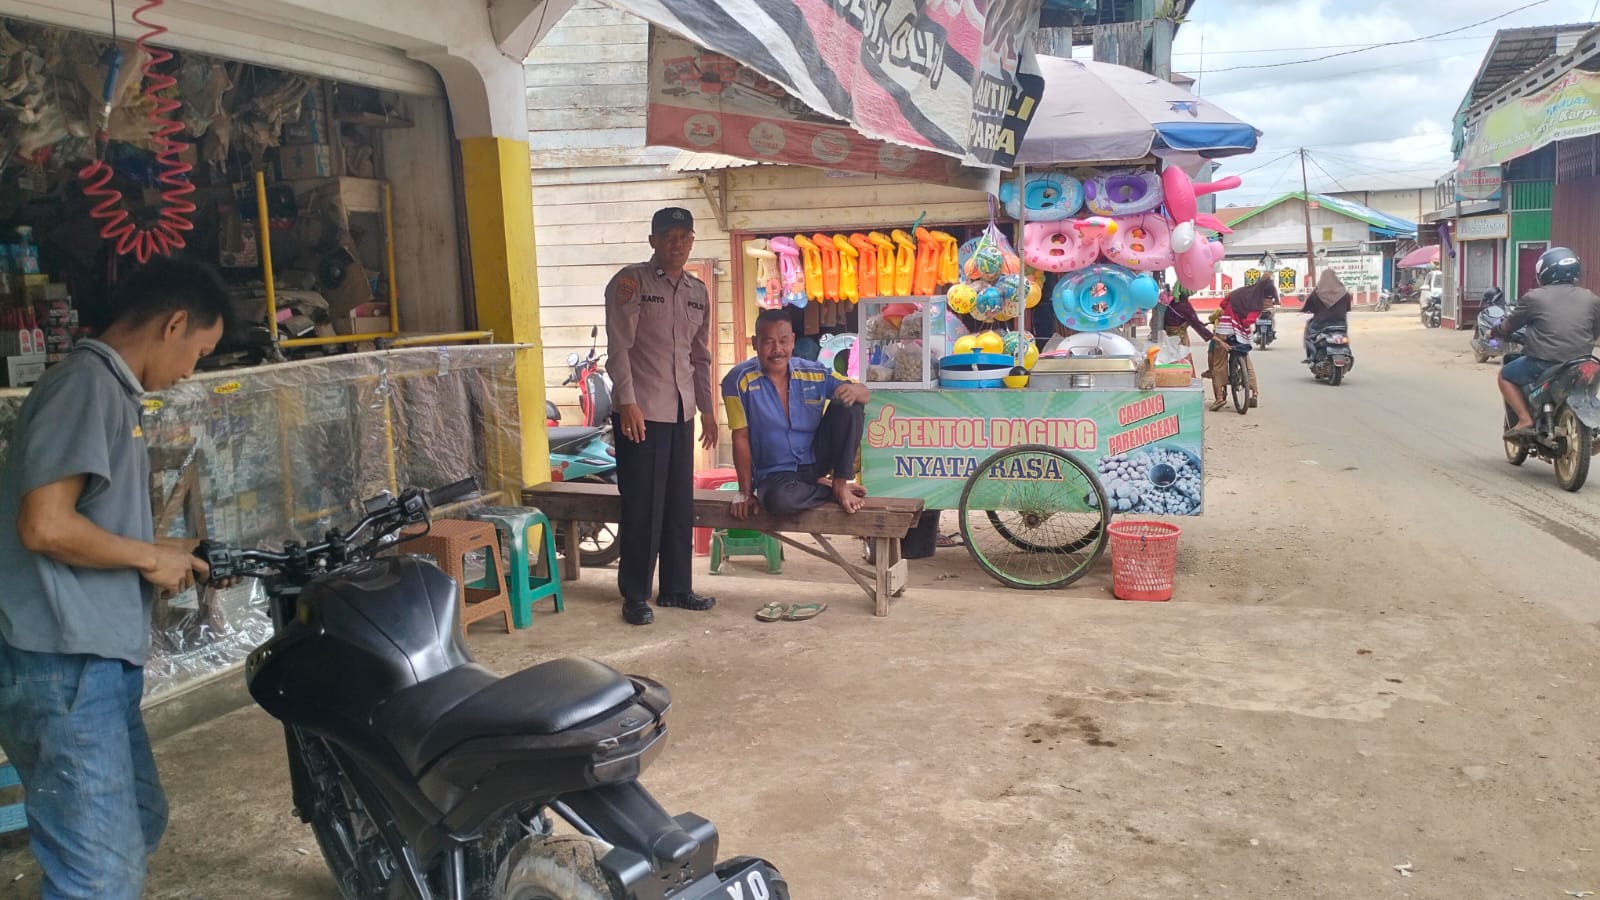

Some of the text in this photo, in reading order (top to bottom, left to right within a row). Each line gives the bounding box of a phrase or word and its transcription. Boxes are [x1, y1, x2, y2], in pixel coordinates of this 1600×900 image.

[641, 294, 665, 304] KARYO
[1118, 393, 1165, 426] CABANG
[893, 417, 1097, 450] PENTOL DAGING
[1107, 414, 1180, 457] PARENGGEAN
[895, 455, 1063, 481] NYATA RASA
